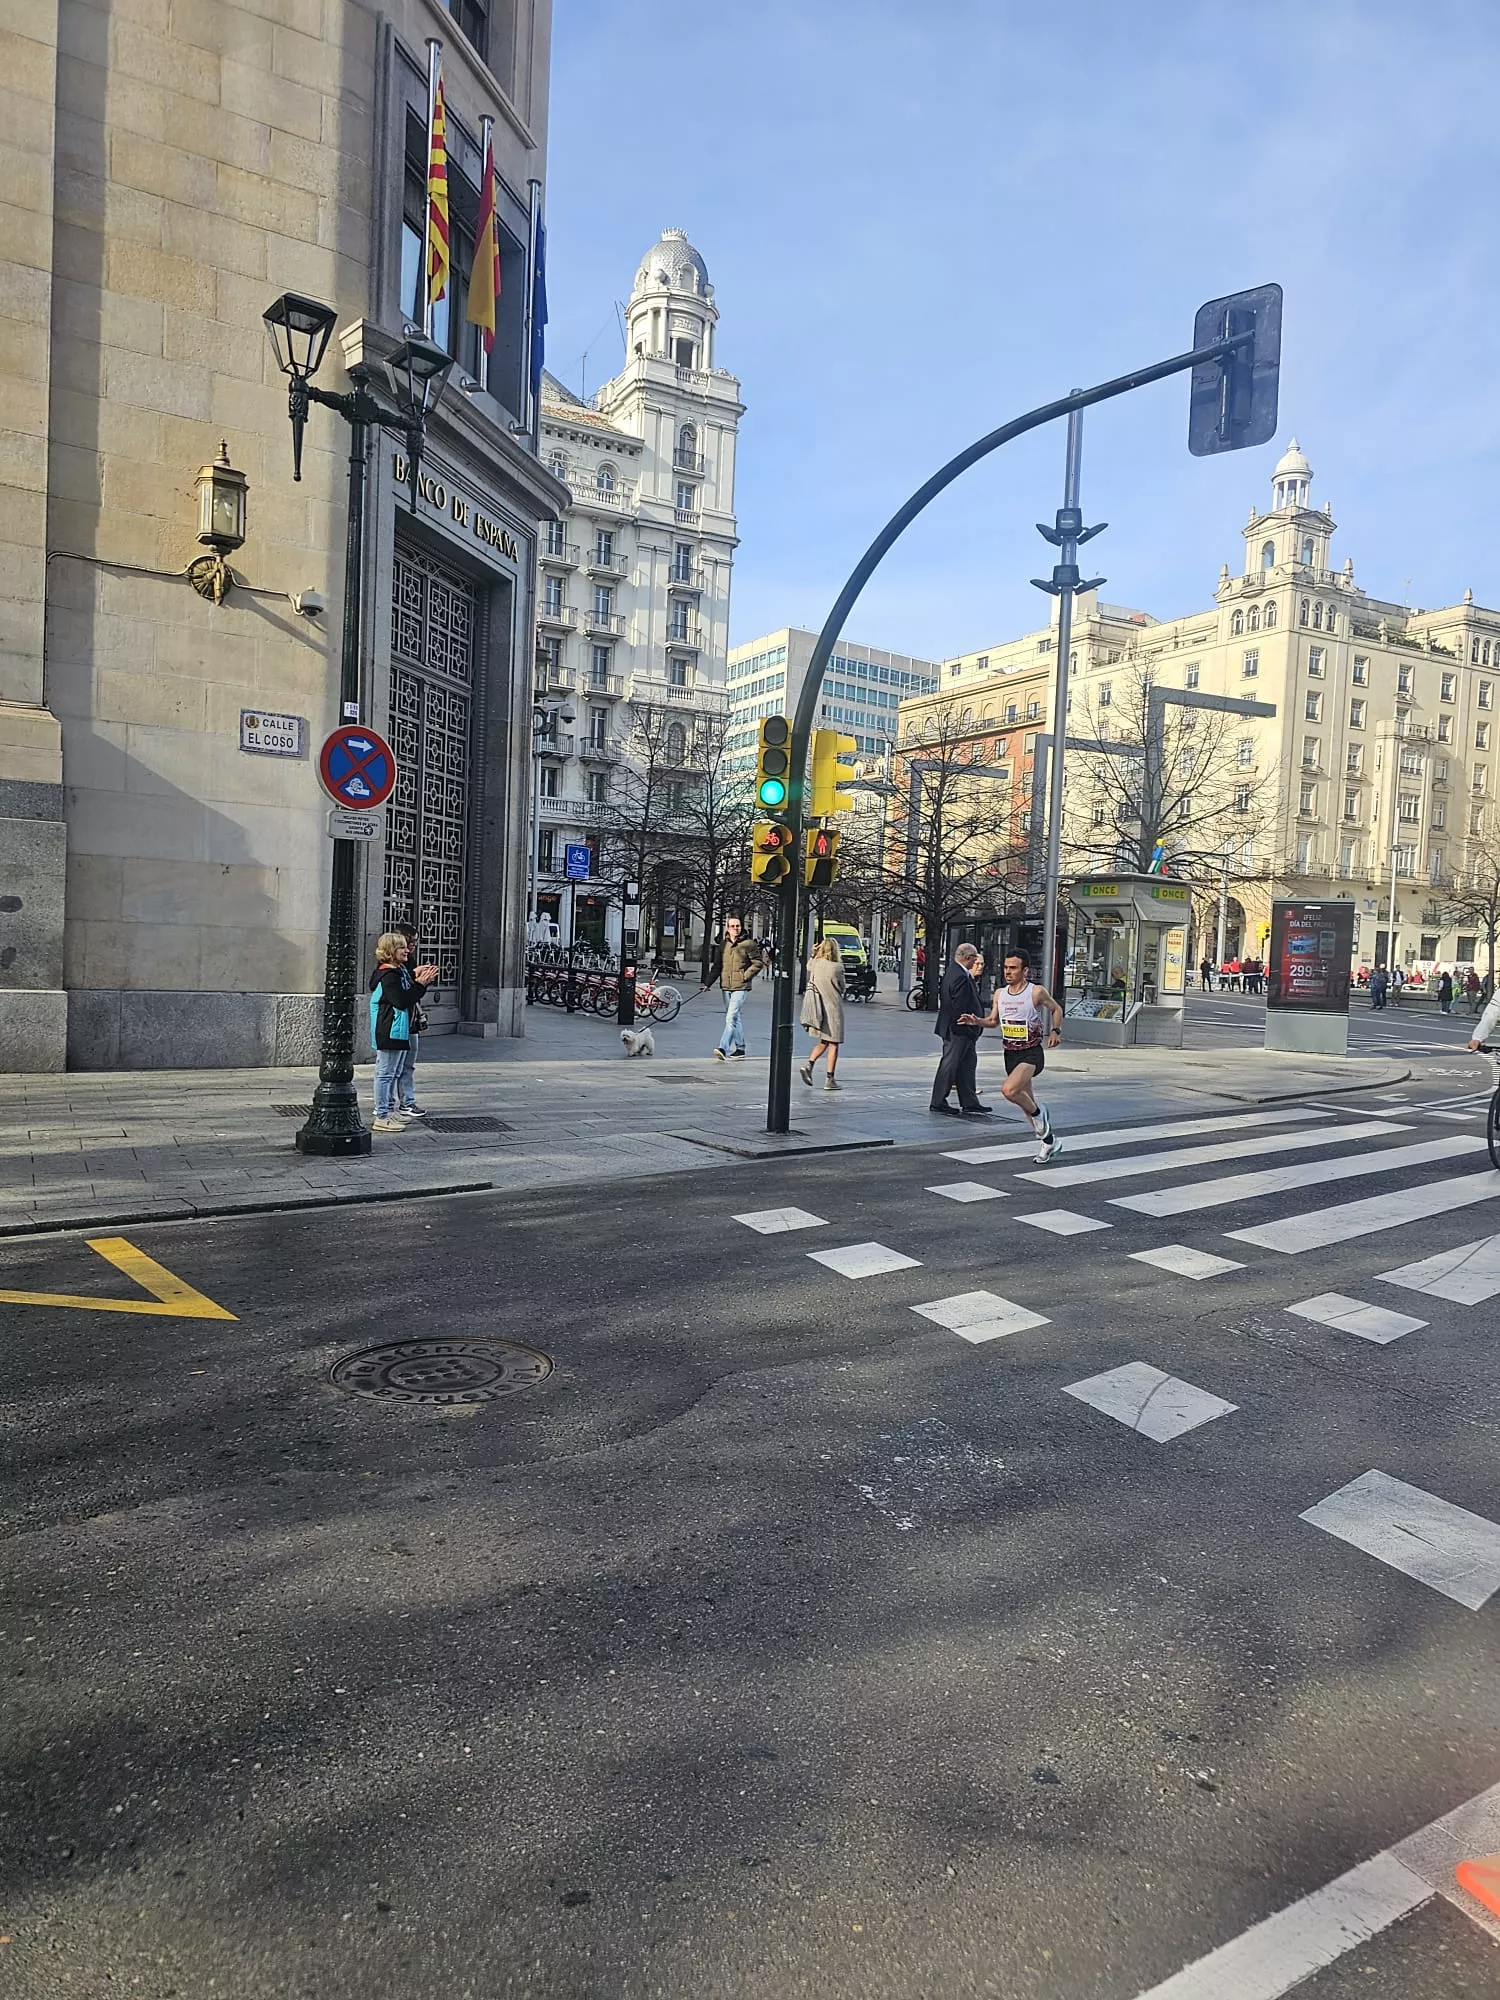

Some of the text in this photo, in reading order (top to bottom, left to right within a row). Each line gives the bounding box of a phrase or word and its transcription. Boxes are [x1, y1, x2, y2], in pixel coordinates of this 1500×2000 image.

[453, 495, 469, 528] DE
[475, 512, 520, 564] ESPAÑA
[262, 718, 295, 731] CALLE
[248, 732, 294, 749] EL COSO
[1092, 885, 1116, 895] ONCE
[1162, 889, 1185, 899] ONCE
